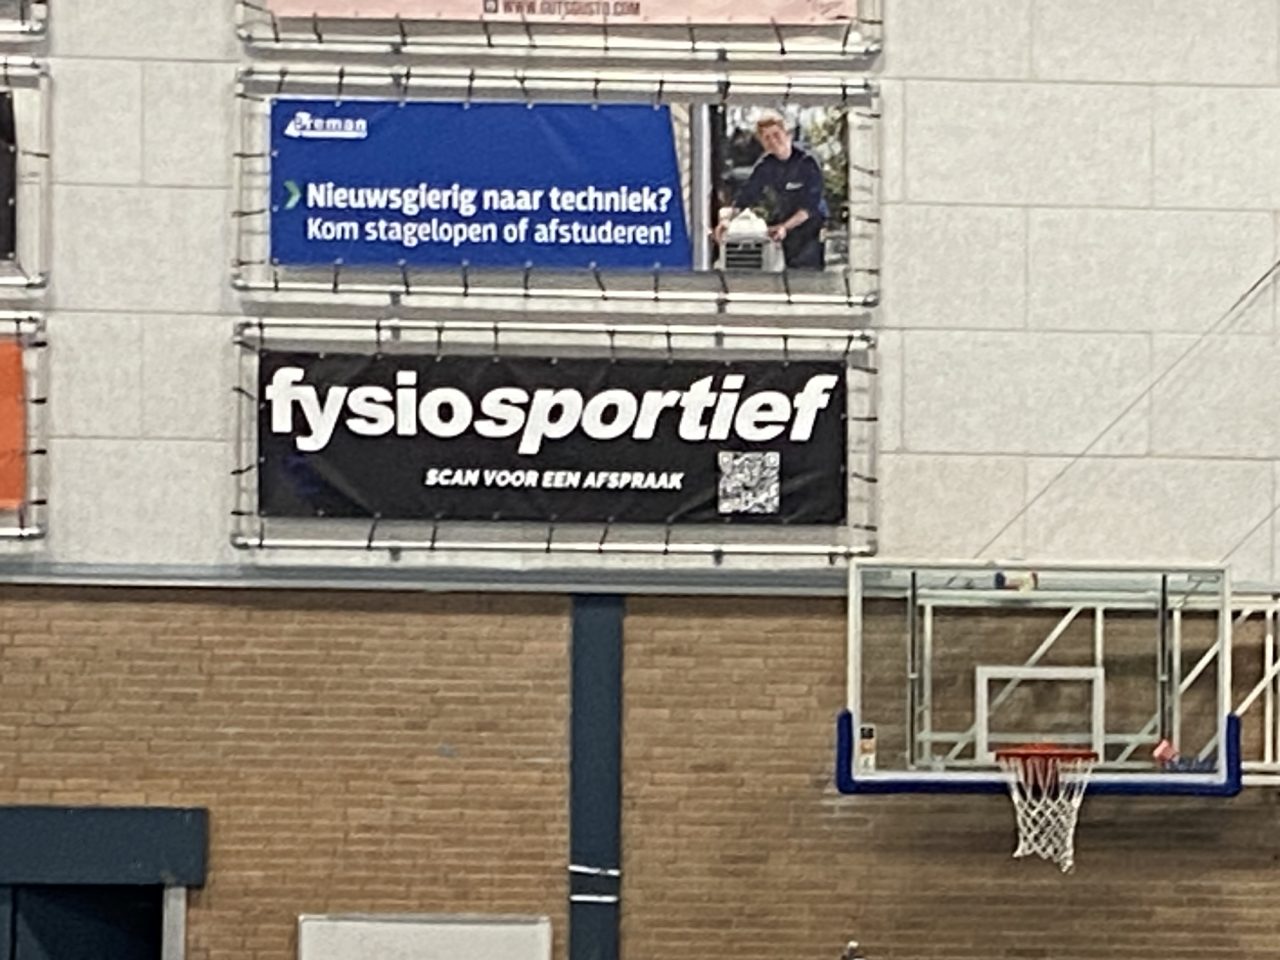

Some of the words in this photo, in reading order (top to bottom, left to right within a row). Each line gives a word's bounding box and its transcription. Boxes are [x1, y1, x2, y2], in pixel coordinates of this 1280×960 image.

[306, 181, 477, 216] Nieuwsgierig
[482, 188, 544, 211] naar
[549, 186, 672, 212] techniek?
[307, 217, 359, 240] Kom
[364, 217, 498, 247] stagelopen
[503, 217, 529, 243] of
[534, 218, 672, 245] afstuderen!
[265, 367, 839, 455] fysiosportief
[425, 469, 480, 486] SCAN
[483, 470, 540, 488] VOOR
[541, 471, 581, 488] EEN
[582, 472, 685, 490] AFSPRAAK
